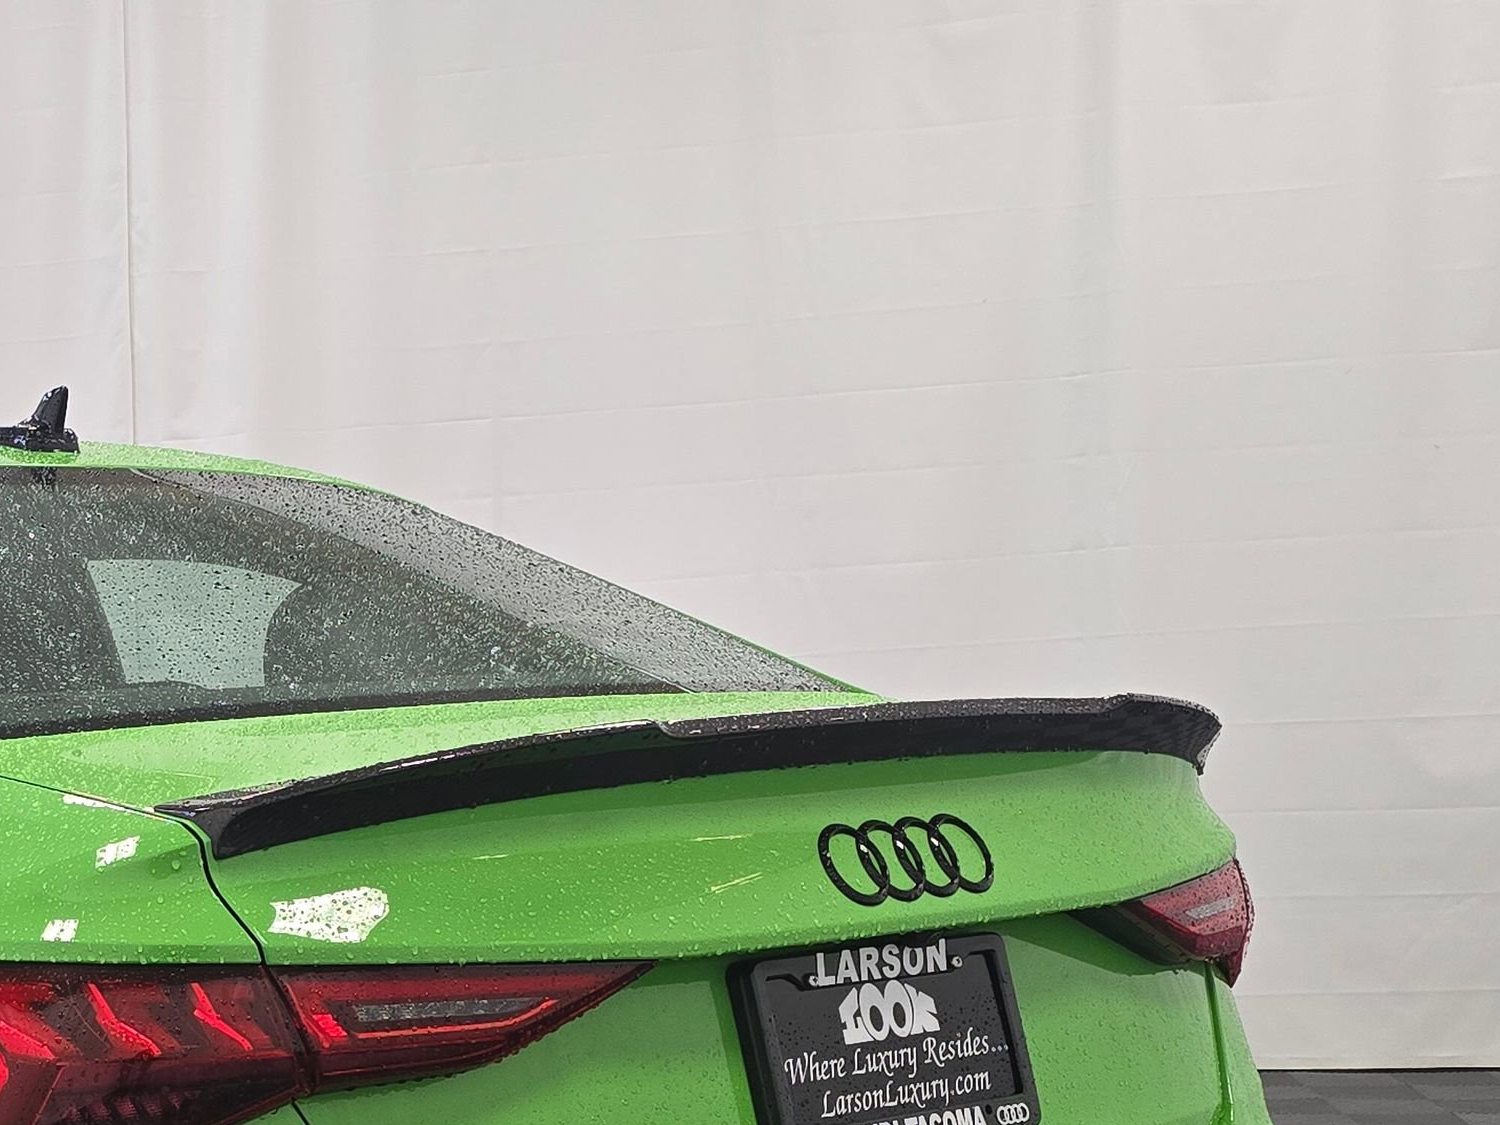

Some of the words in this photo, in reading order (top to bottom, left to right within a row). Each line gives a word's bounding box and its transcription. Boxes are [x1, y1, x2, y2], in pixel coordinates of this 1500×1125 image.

[815, 938, 948, 987] LARSON
[784, 1052, 847, 1085] Where
[852, 1045, 917, 1078] Luxury
[923, 1027, 1009, 1067] Resides...
[821, 1070, 992, 1119] LarsonLuxury.com
